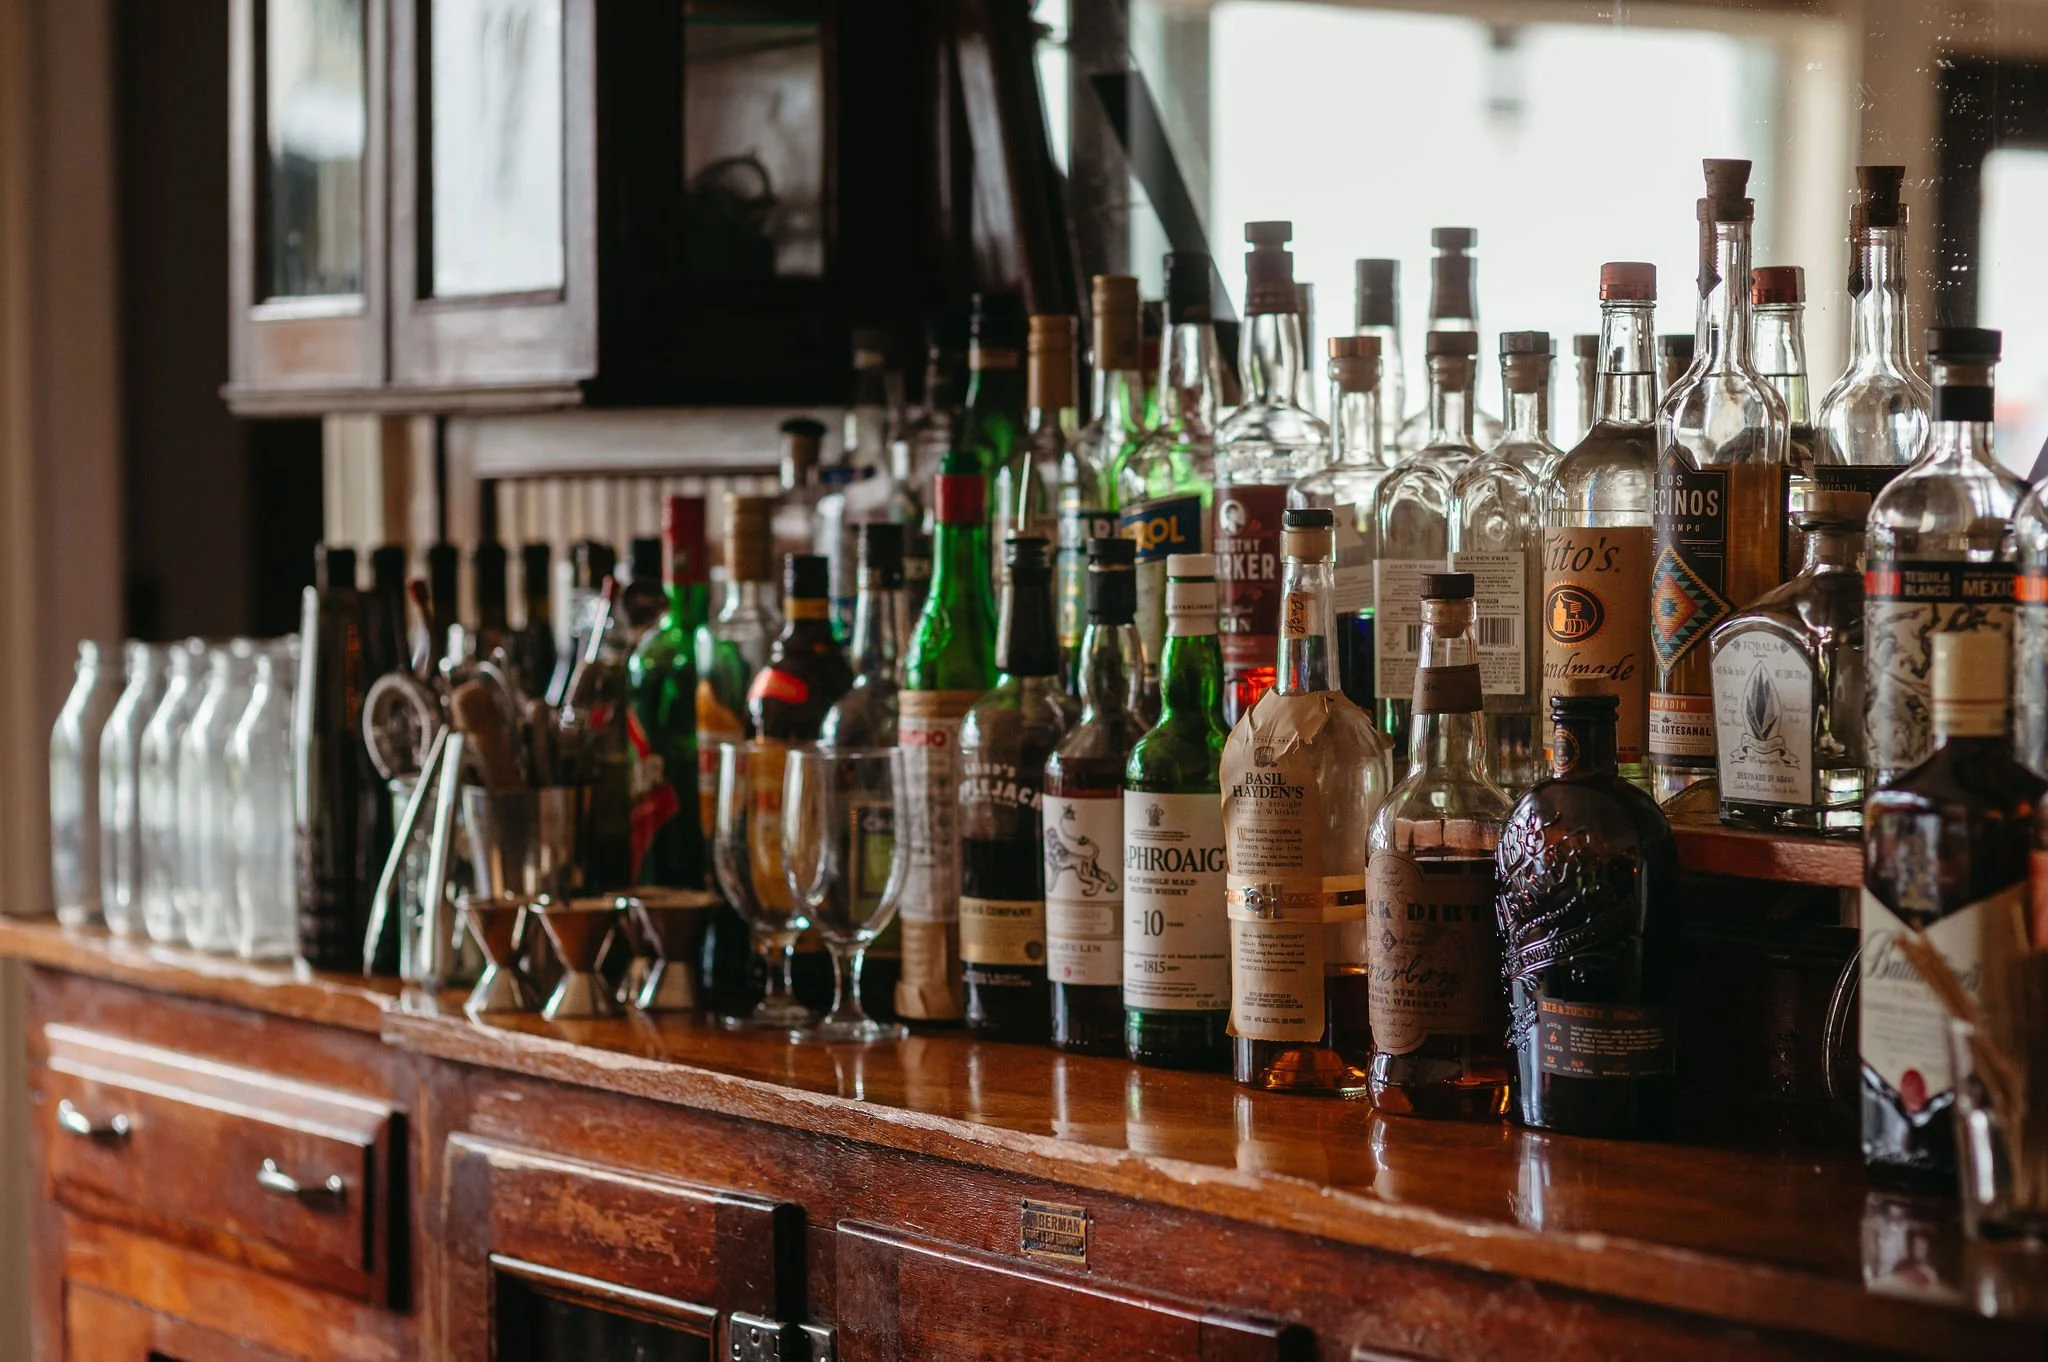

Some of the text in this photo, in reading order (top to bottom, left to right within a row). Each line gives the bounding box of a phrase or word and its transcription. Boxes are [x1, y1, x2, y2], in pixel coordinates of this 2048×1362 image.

[1660, 474, 1683, 487] LOS
[1121, 514, 1186, 553] ROL
[1665, 523, 1700, 532] CAMPO
[1215, 552, 1276, 581] ARKER
[1904, 571, 1950, 583] TEQUILA
[1904, 584, 1951, 597] BLANCO
[1962, 579, 2014, 597] MEXIC
[1219, 616, 1251, 633] GIN
[1661, 725, 1712, 737] ARTESANAL
[1245, 772, 1287, 786] BASIL
[1232, 785, 1305, 799] HAYDEN'S
[1123, 844, 1225, 873] PHROAIG
[1407, 902, 1485, 922] DIRT
[1143, 909, 1164, 937] 10
[1143, 960, 1165, 974] 1815
[1368, 952, 1462, 986] ourbon
[1549, 1031, 1557, 1043] 6
[1544, 1043, 1564, 1053] YEARS
[1037, 1212, 1081, 1235] BERMAN
